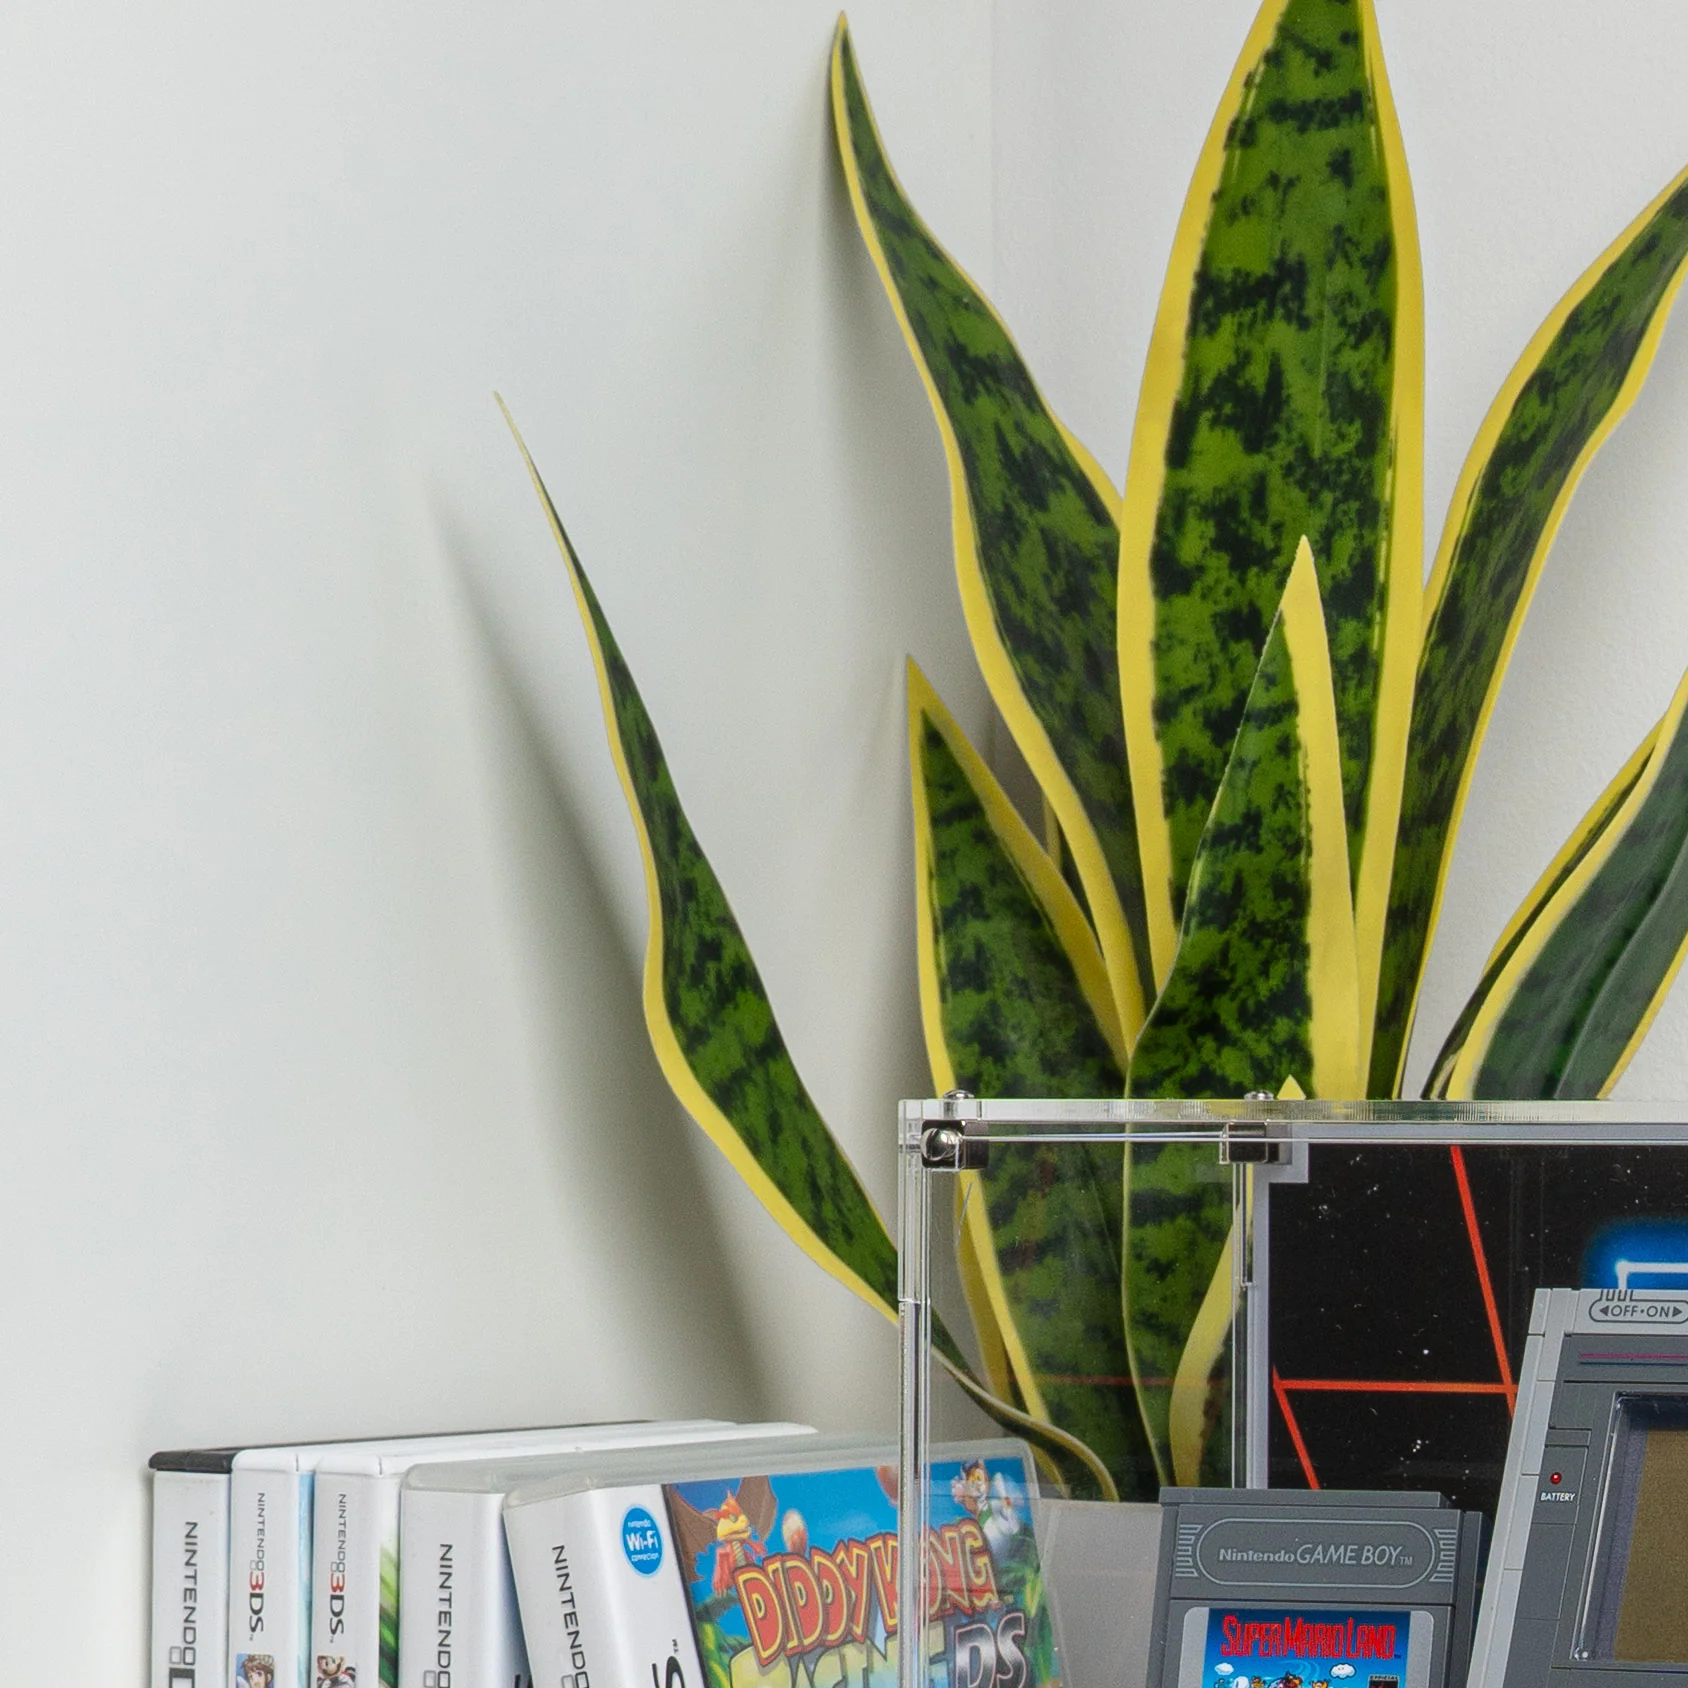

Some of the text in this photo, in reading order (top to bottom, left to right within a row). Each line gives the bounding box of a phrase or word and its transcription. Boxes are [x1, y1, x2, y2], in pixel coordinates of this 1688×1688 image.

[1541, 1491, 1576, 1502] BATTERY
[256, 1492, 265, 1571] NINTENDO
[337, 1493, 346, 1572] NINTENDO
[625, 1530, 659, 1551] Wi-Fi
[1218, 1547, 1295, 1564] Nintendo
[1296, 1544, 1358, 1566] GAME
[182, 1521, 198, 1666] NINTENDO
[732, 1543, 872, 1668] DIDDY
[1220, 1614, 1397, 1661] SUPER MARIO LAND
